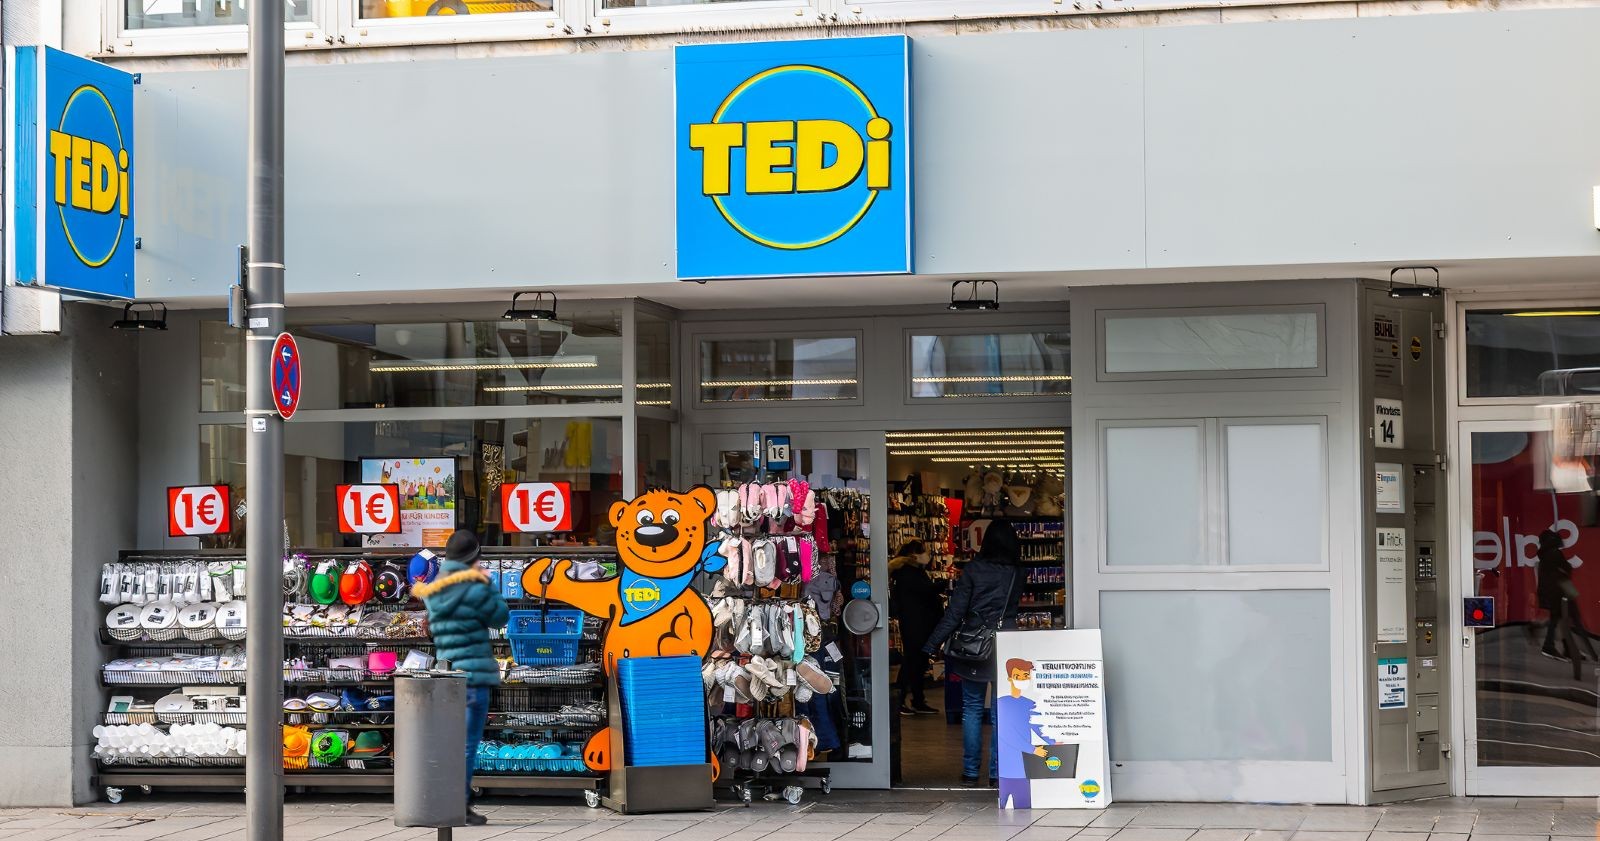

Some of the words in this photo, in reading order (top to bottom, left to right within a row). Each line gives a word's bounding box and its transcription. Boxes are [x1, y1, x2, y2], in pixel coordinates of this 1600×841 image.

[50, 129, 129, 219] TEDi
[689, 117, 893, 196] TEDi
[1380, 420, 1395, 443] 14
[773, 447, 785, 459] 1€
[181, 493, 217, 528] 1€
[350, 491, 387, 526] 1€
[516, 489, 557, 525] 1€
[624, 587, 661, 603] TEDi
